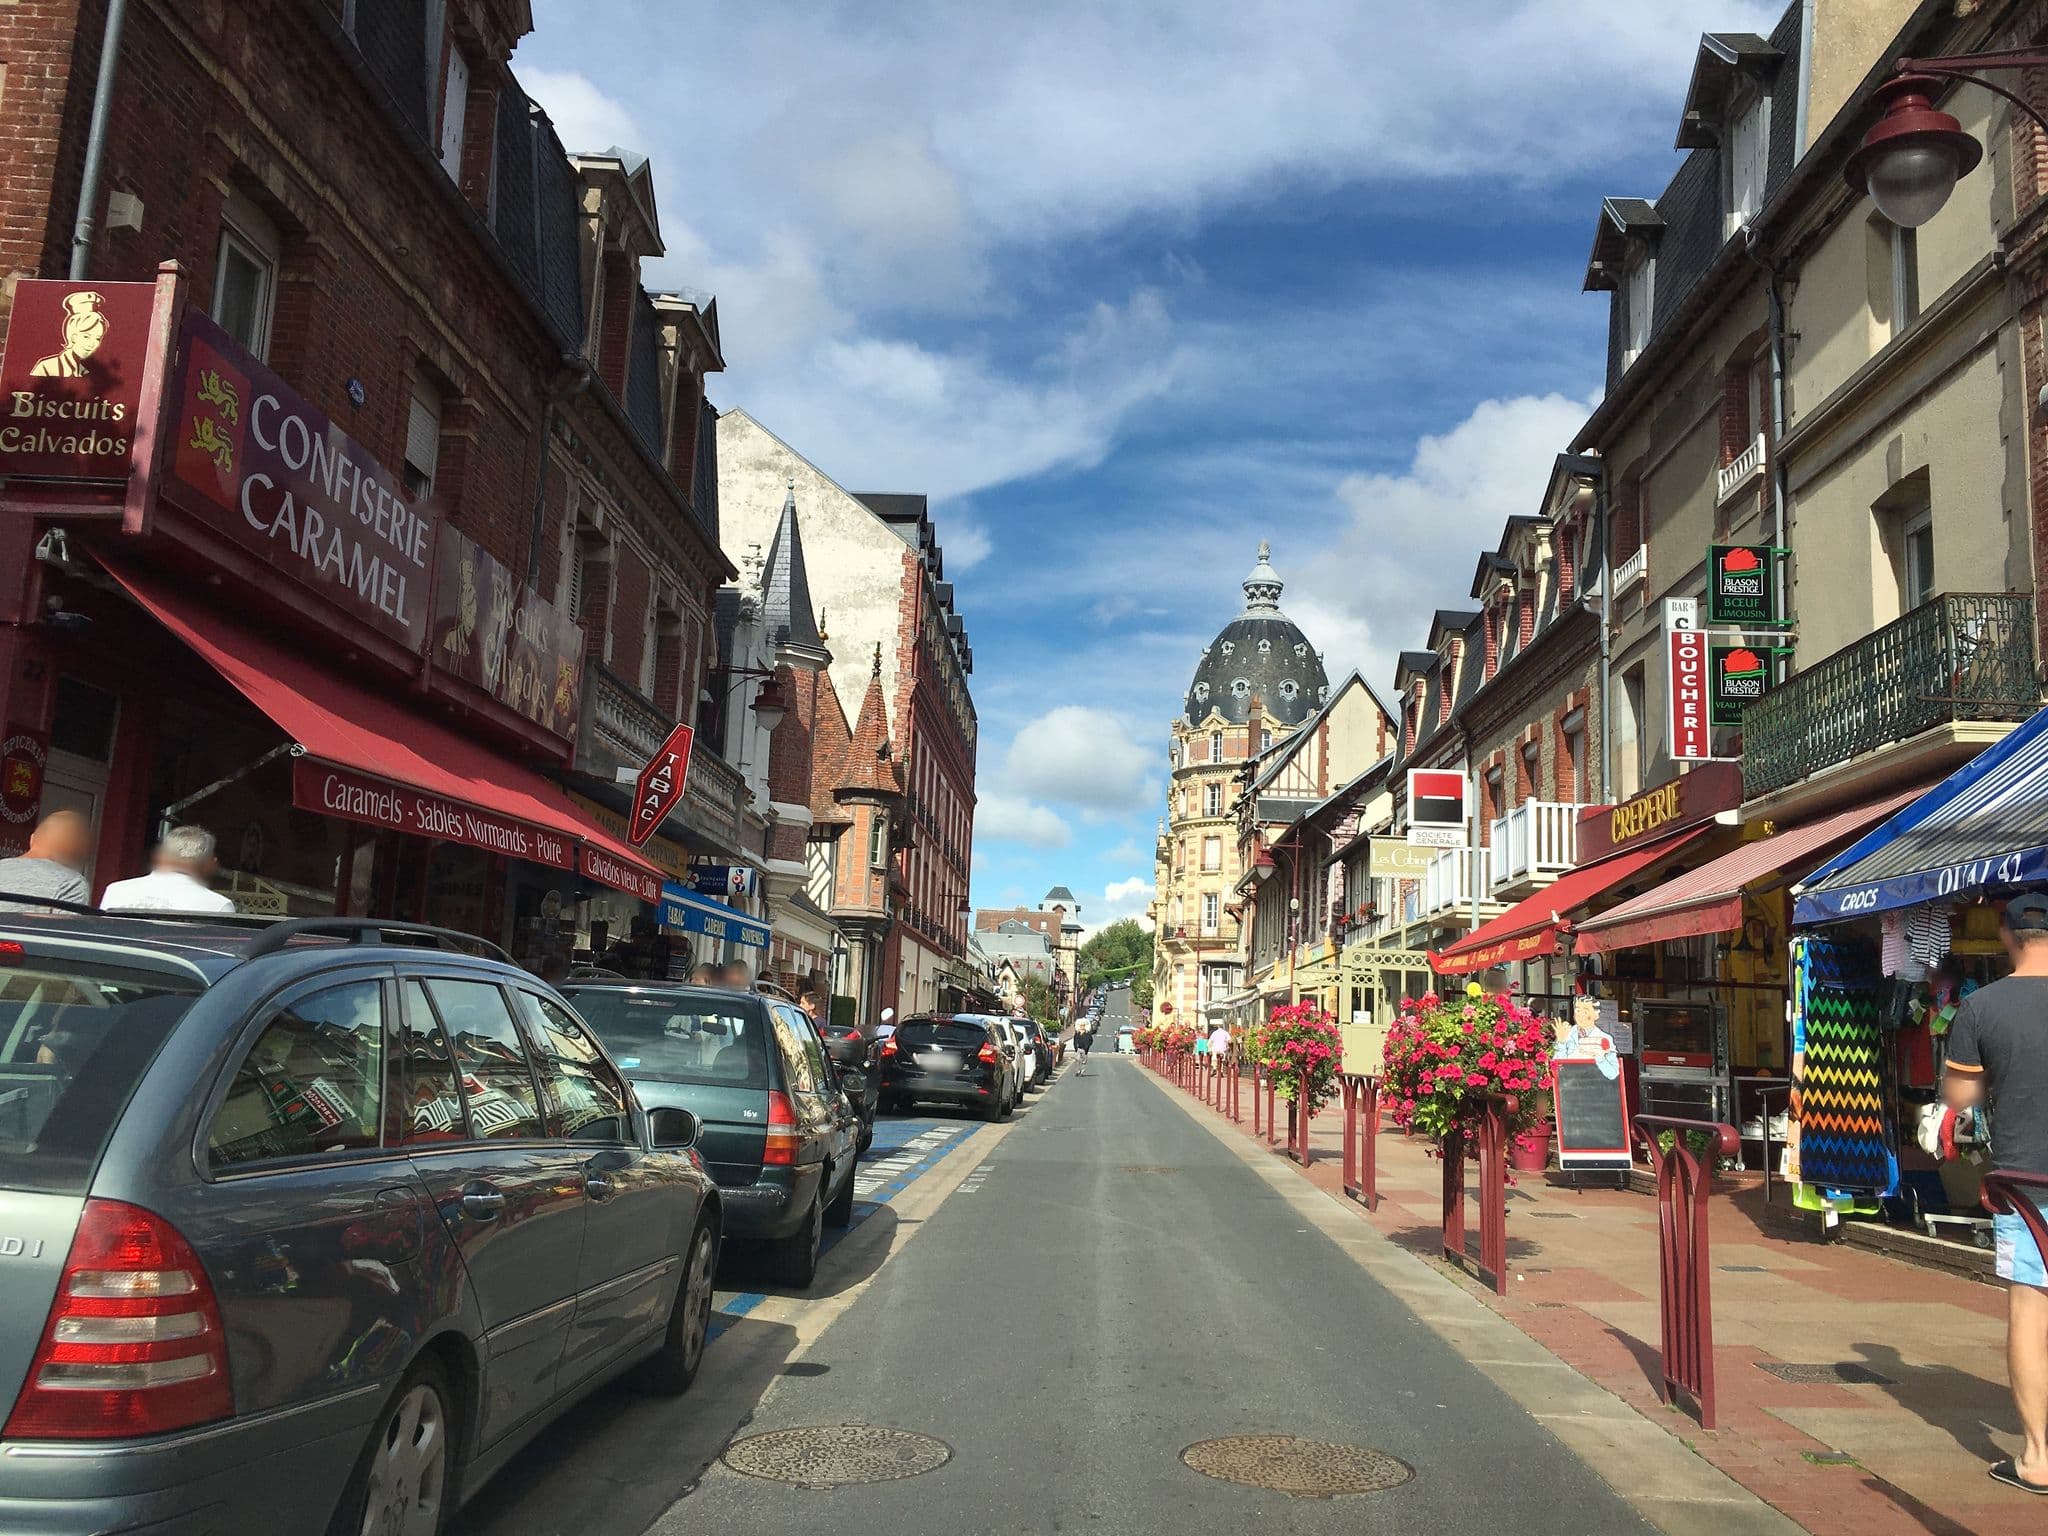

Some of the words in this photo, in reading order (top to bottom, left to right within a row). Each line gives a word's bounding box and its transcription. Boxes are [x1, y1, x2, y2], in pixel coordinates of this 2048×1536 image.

[9, 391, 125, 420] Biscuits
[0, 426, 127, 455] Calvados
[252, 394, 430, 568] CONFISERIE
[241, 473, 410, 626] CARAMEL
[1723, 585, 1760, 593] PRESTIGE
[1724, 578, 1759, 586] BLASON
[1671, 601, 1689, 612] BAR
[1719, 609, 1766, 618] LIMOUSIN
[1678, 633, 1699, 757] BOUCHERIE
[1724, 687, 1761, 695] PRESTIGE
[1725, 680, 1760, 688] BLASON
[1715, 701, 1736, 709] VEAU
[641, 752, 680, 821] TABAC
[323, 774, 402, 824] Caramels
[416, 799, 463, 838] Sablés
[465, 812, 527, 854] Normands
[537, 832, 562, 864] Poiré
[588, 850, 620, 885] Calvados
[620, 867, 639, 893] vieux
[641, 875, 657, 900] Cidre
[1997, 852, 2024, 883] 42
[1839, 887, 1879, 912] CROCS
[667, 905, 686, 927] TABAC
[0, 1236, 45, 1258] DI
